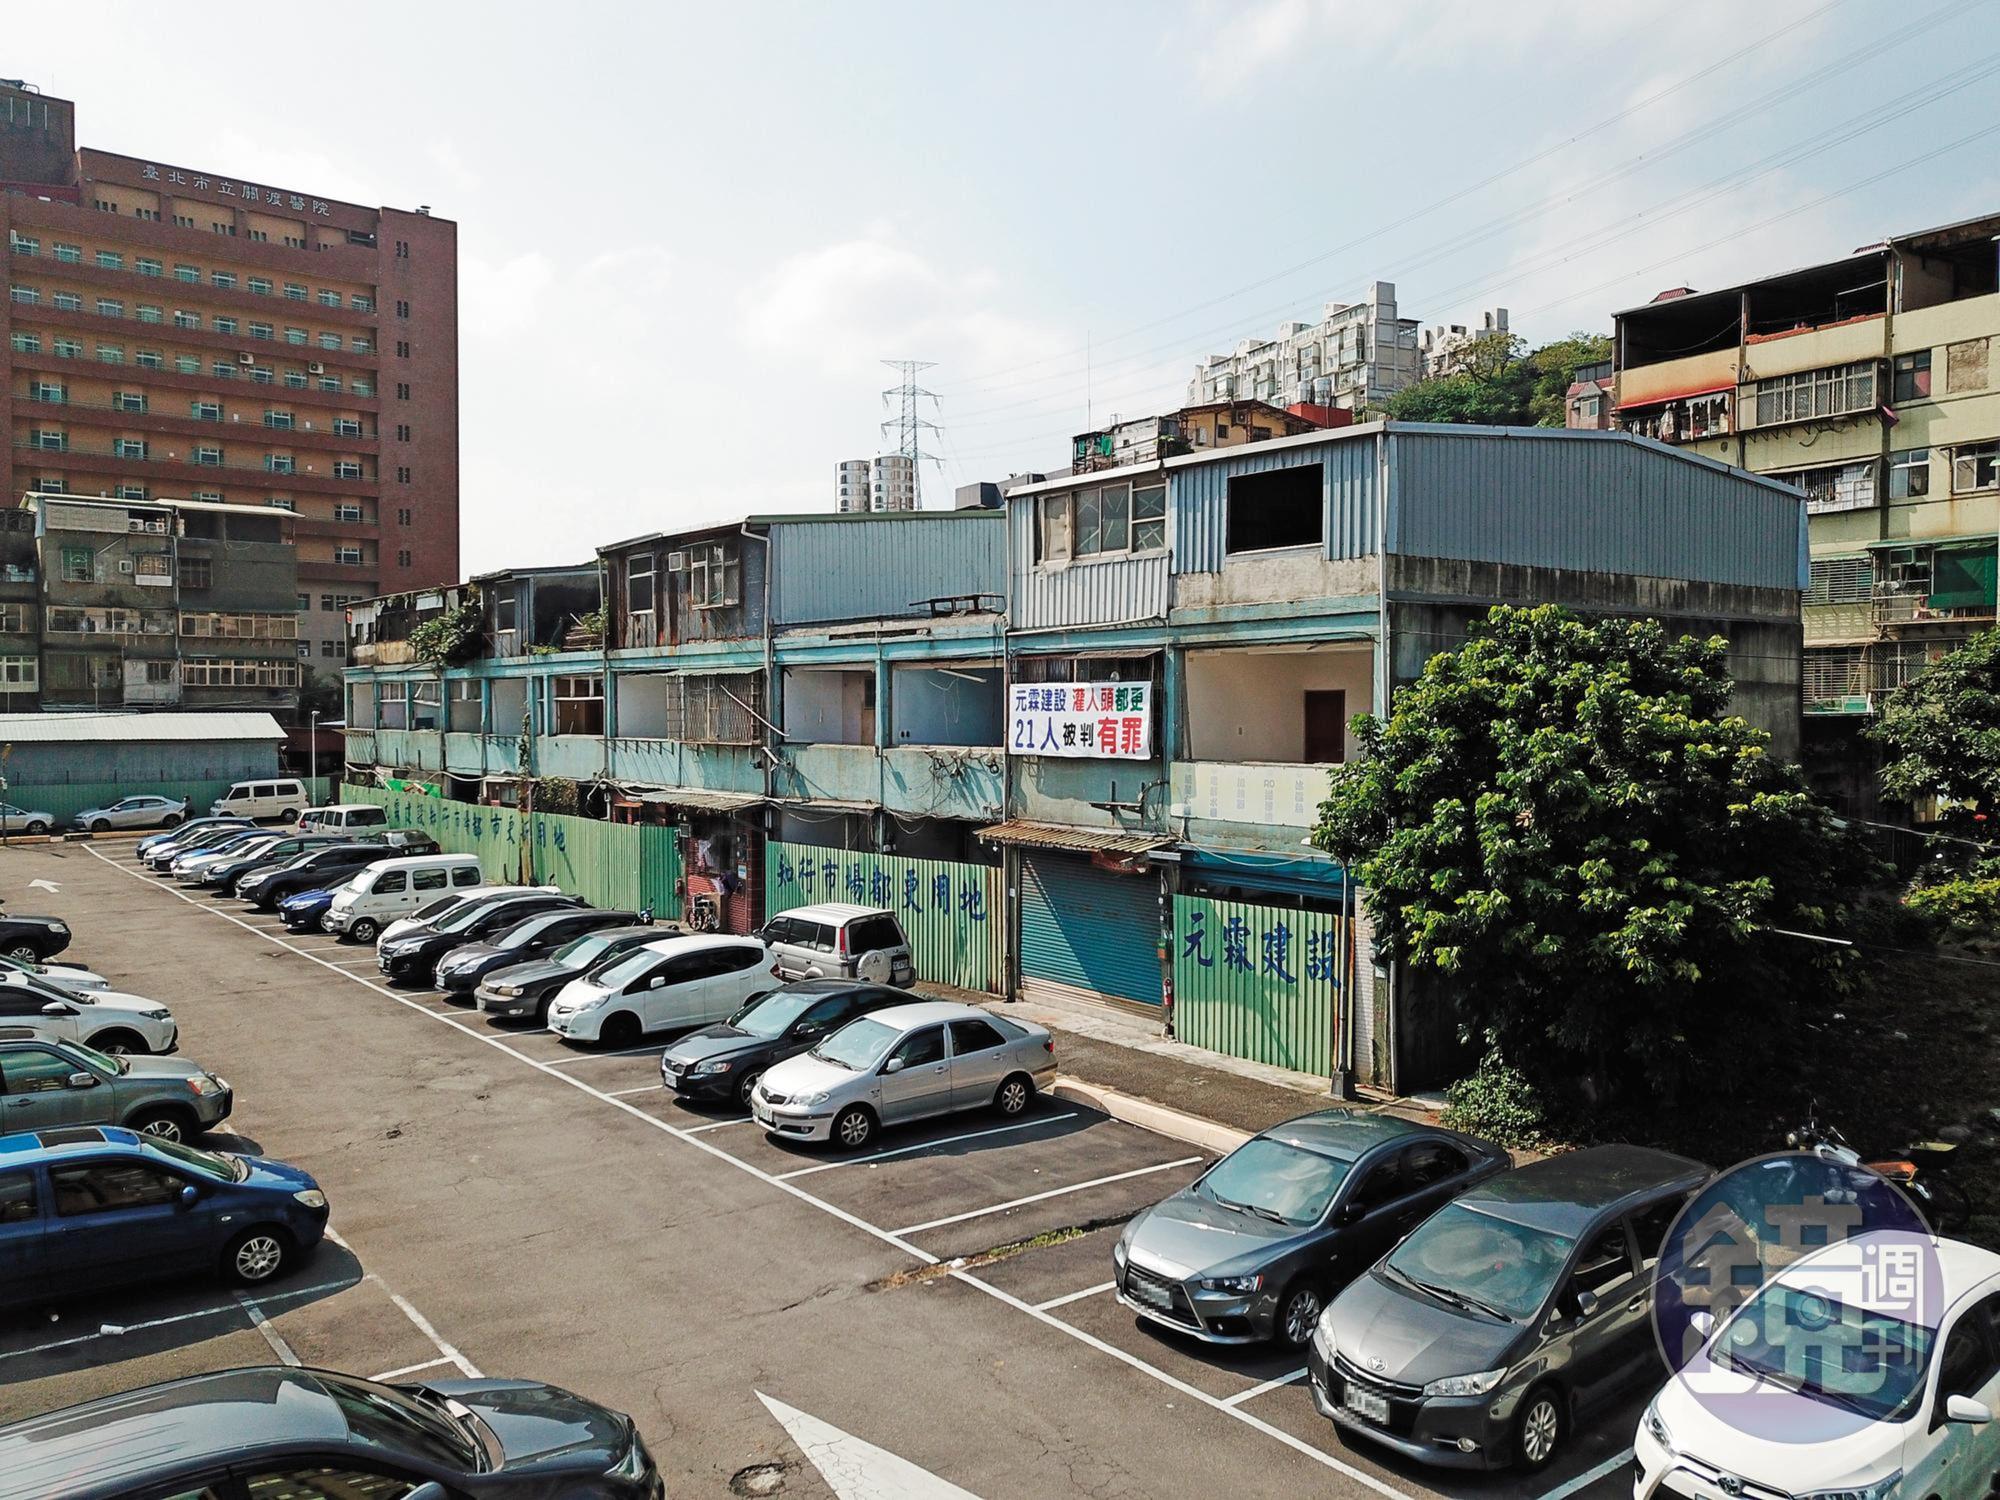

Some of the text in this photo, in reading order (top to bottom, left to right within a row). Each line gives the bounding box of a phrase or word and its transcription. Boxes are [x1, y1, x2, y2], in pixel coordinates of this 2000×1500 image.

[142, 164, 331, 217] 臺北市立關渡醫院
[1015, 687, 1144, 712] 元霖建設 灌人頭都更
[777, 852, 986, 922] 知行市場都更用地
[1183, 912, 1342, 989] 元霖建設
